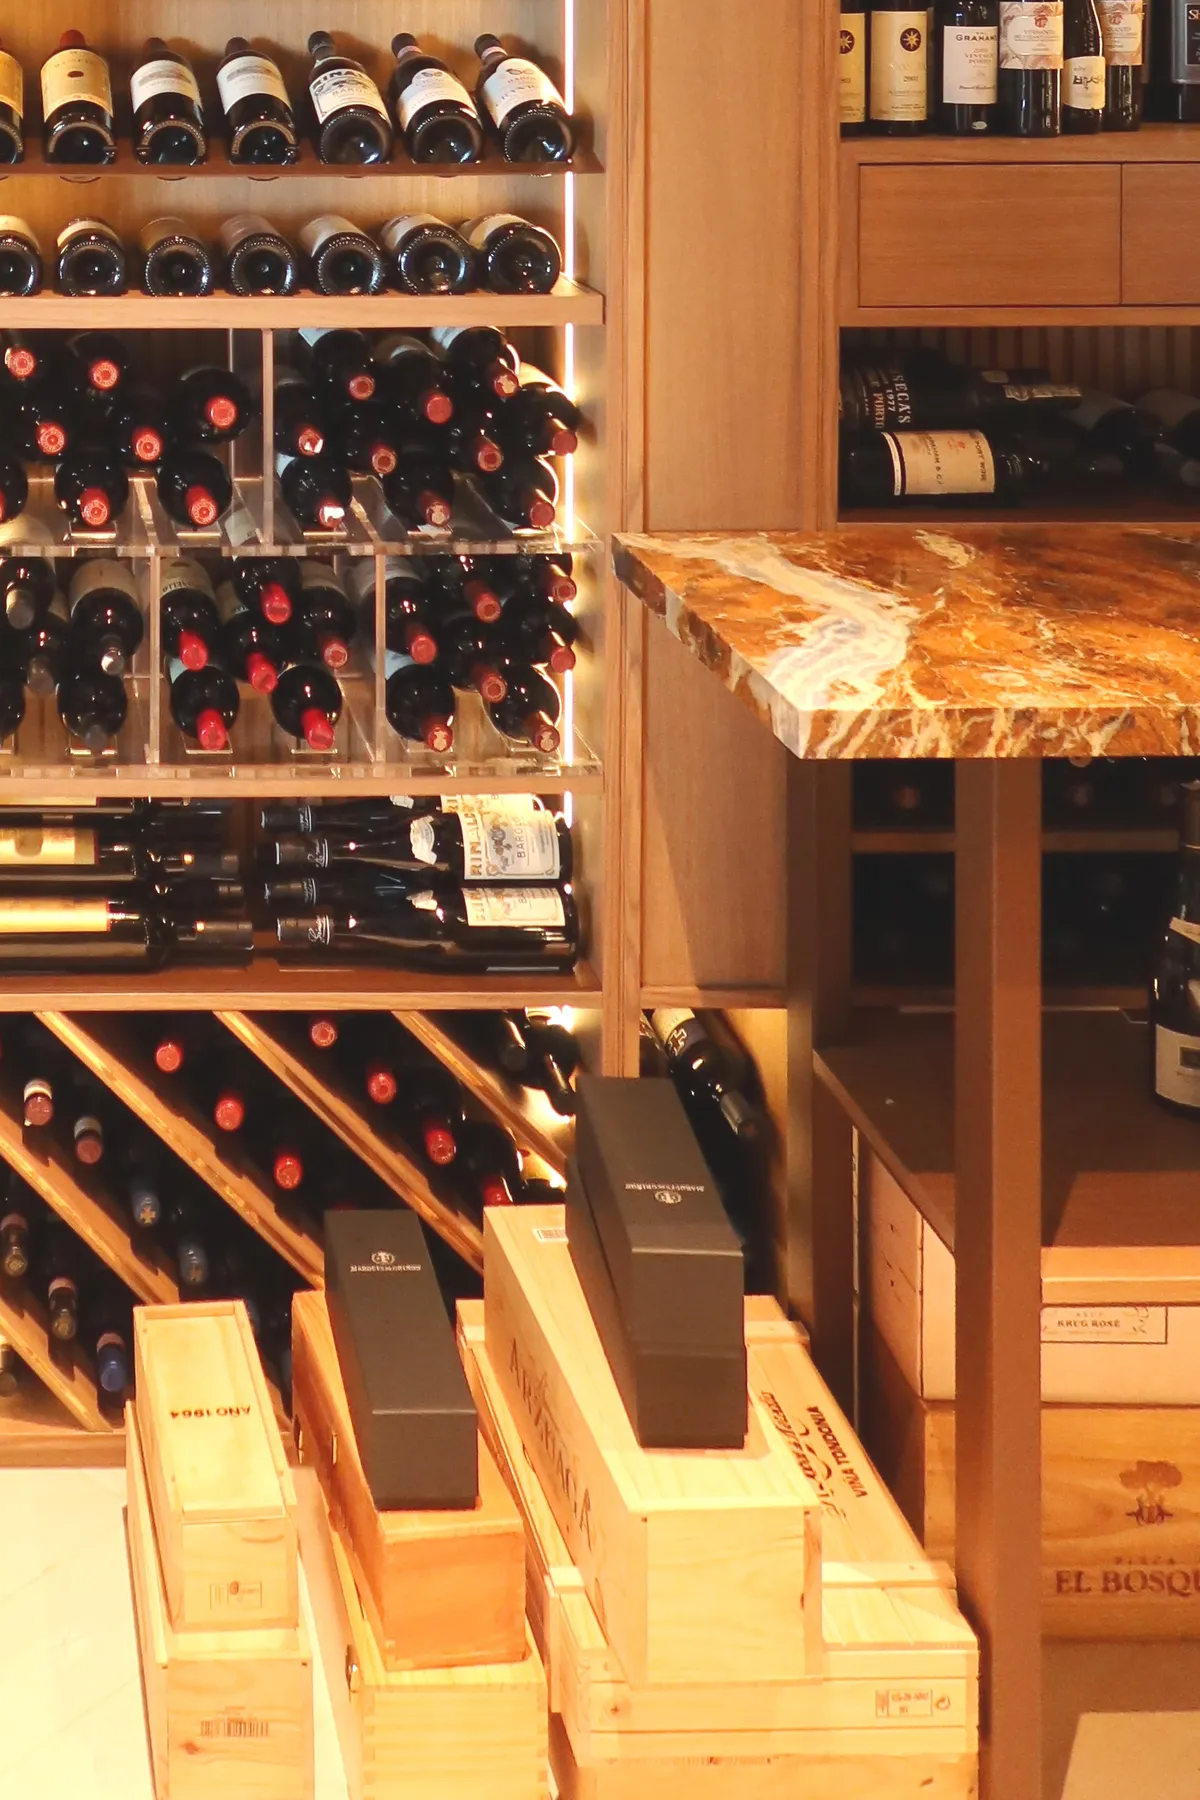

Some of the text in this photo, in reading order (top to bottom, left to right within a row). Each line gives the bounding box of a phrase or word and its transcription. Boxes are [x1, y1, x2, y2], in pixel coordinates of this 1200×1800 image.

[873, 392, 885, 429] PORTO
[885, 389, 896, 412] 1977
[974, 440, 985, 459] PORT
[1057, 1319, 1089, 1328] KRUG
[1056, 1569, 1092, 1593] EL
